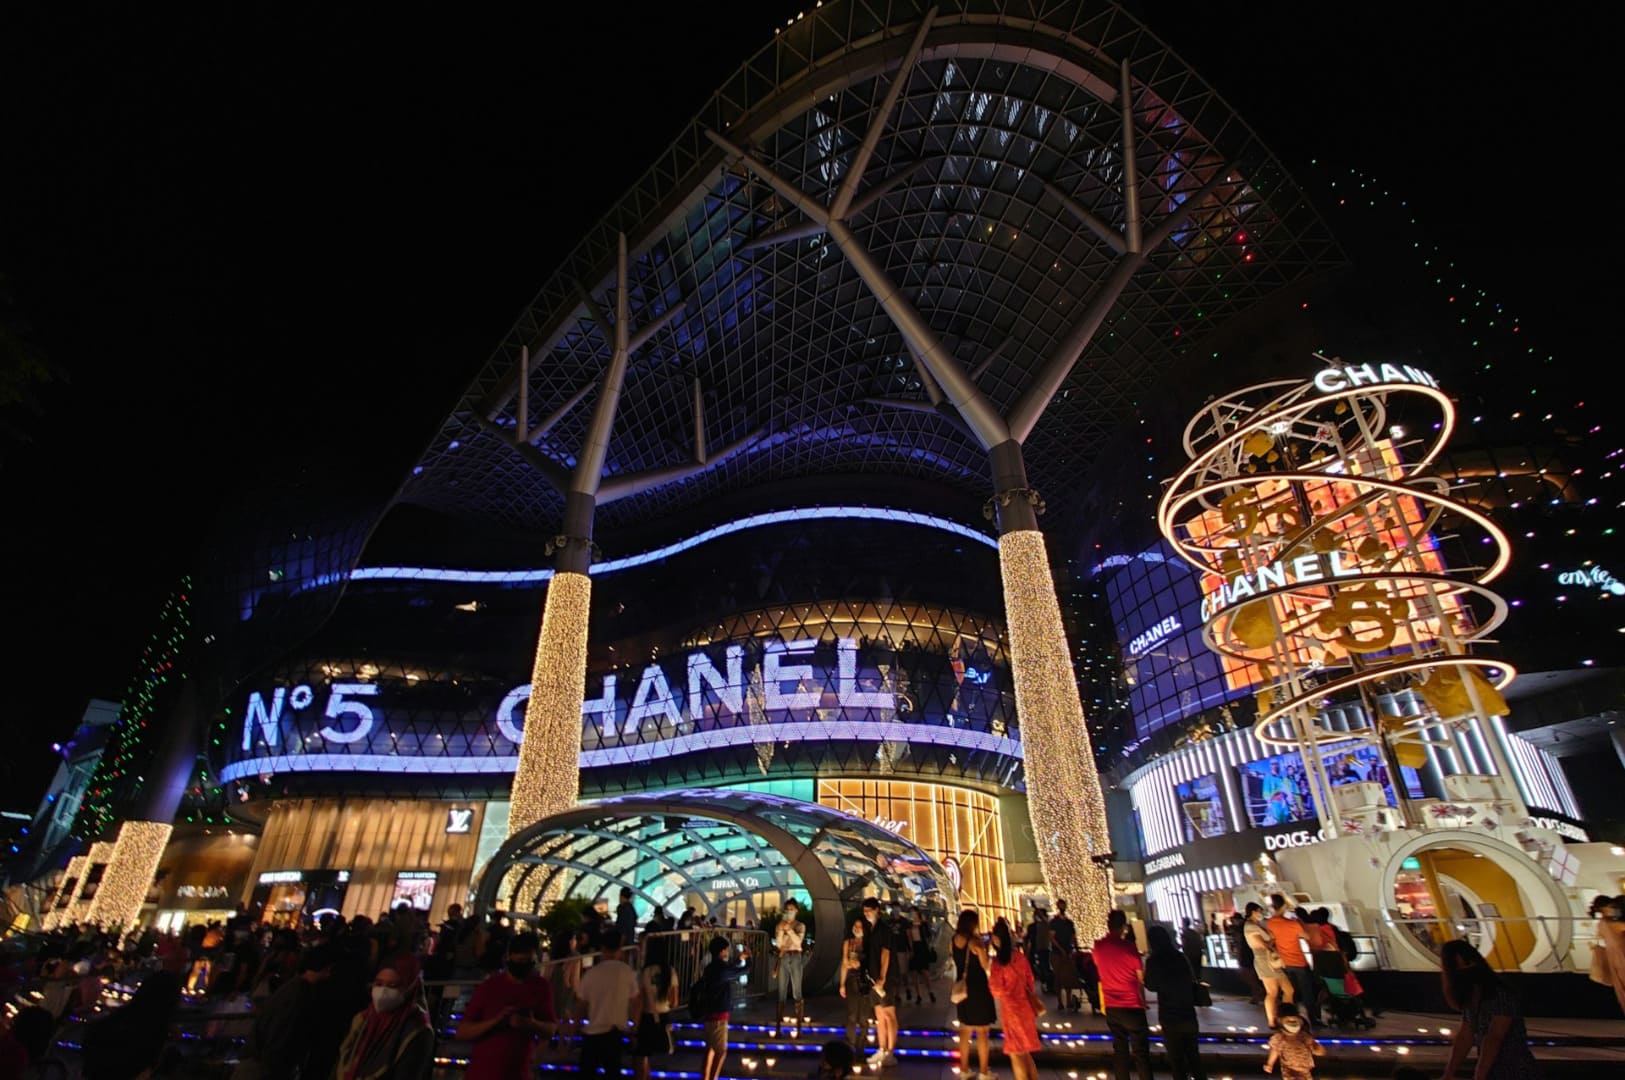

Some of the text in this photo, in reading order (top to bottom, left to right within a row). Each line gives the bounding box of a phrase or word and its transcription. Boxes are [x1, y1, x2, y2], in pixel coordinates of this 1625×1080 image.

[1200, 549, 1361, 623] CHANEL
[1129, 615, 1181, 655] CHANEL
[320, 683, 379, 743] 5
